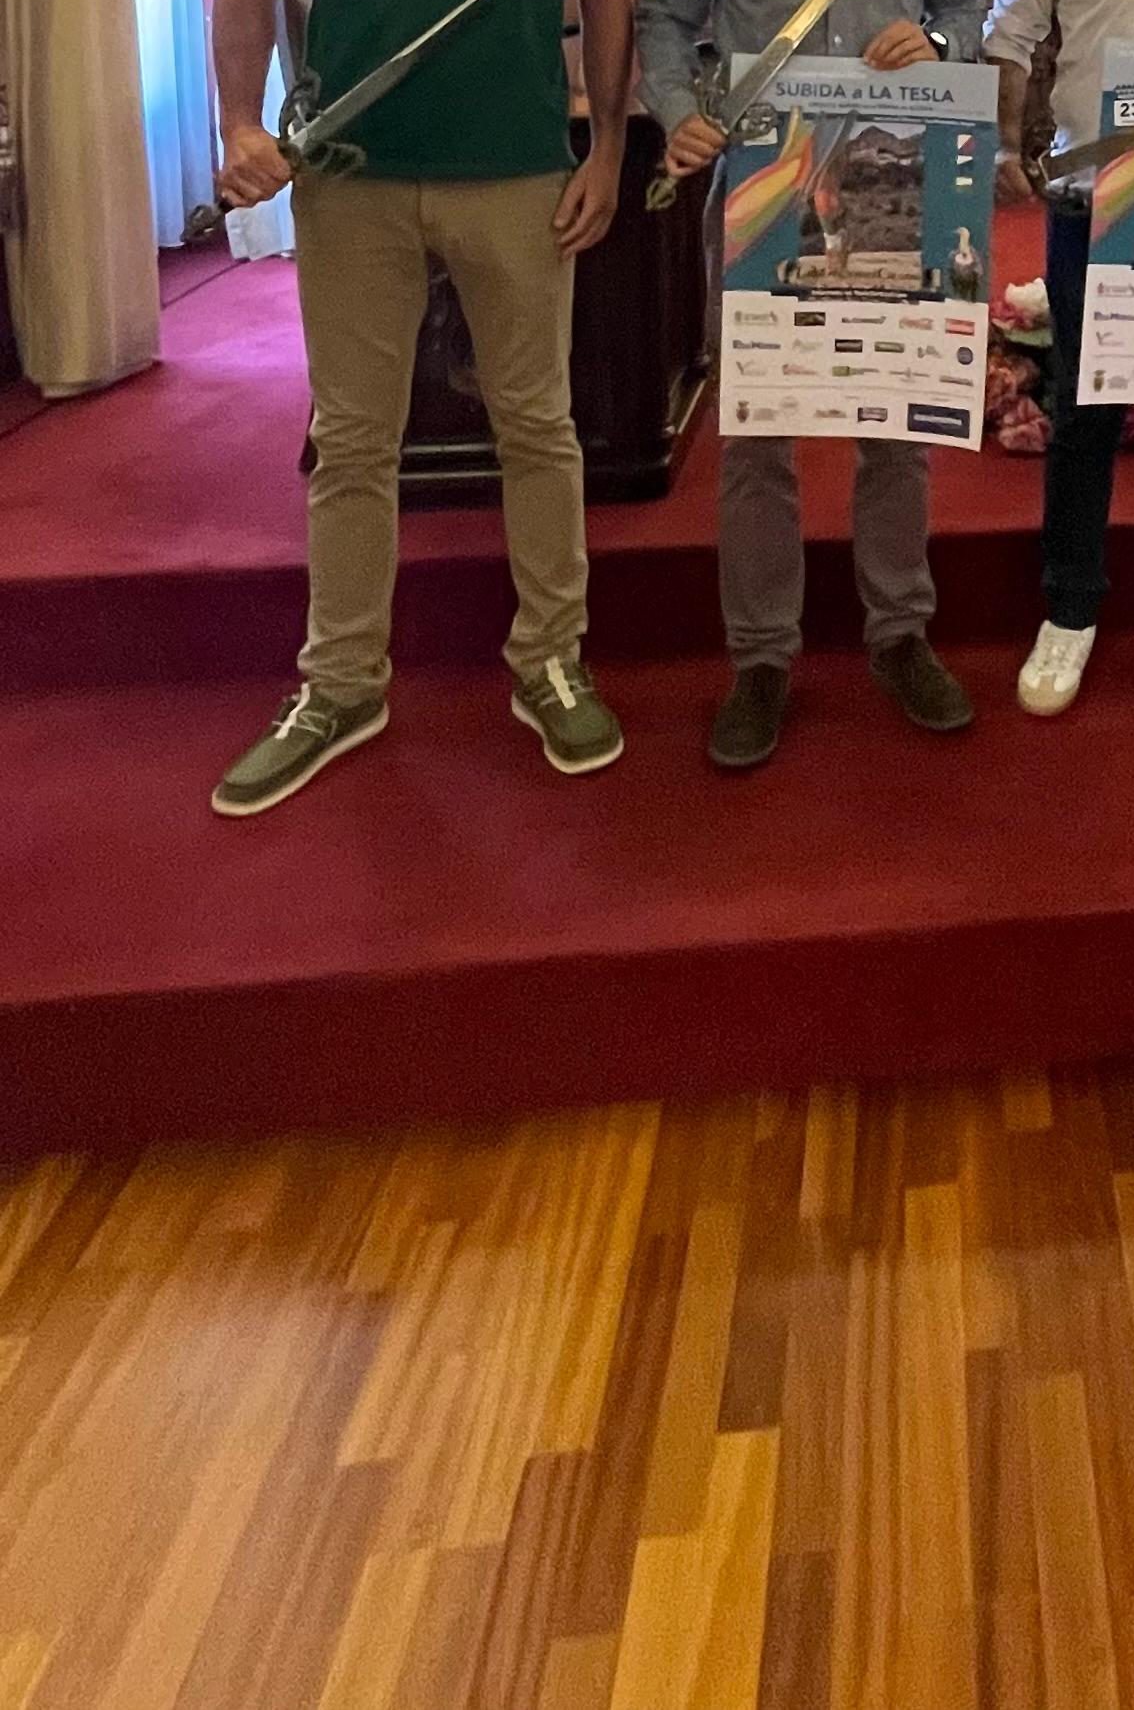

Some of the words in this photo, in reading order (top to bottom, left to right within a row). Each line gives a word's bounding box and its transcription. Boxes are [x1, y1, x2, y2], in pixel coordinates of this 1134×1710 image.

[776, 81, 847, 99] SUBIDA
[851, 86, 862, 99] a
[869, 85, 892, 100] LA
[900, 86, 954, 103] TESLA
